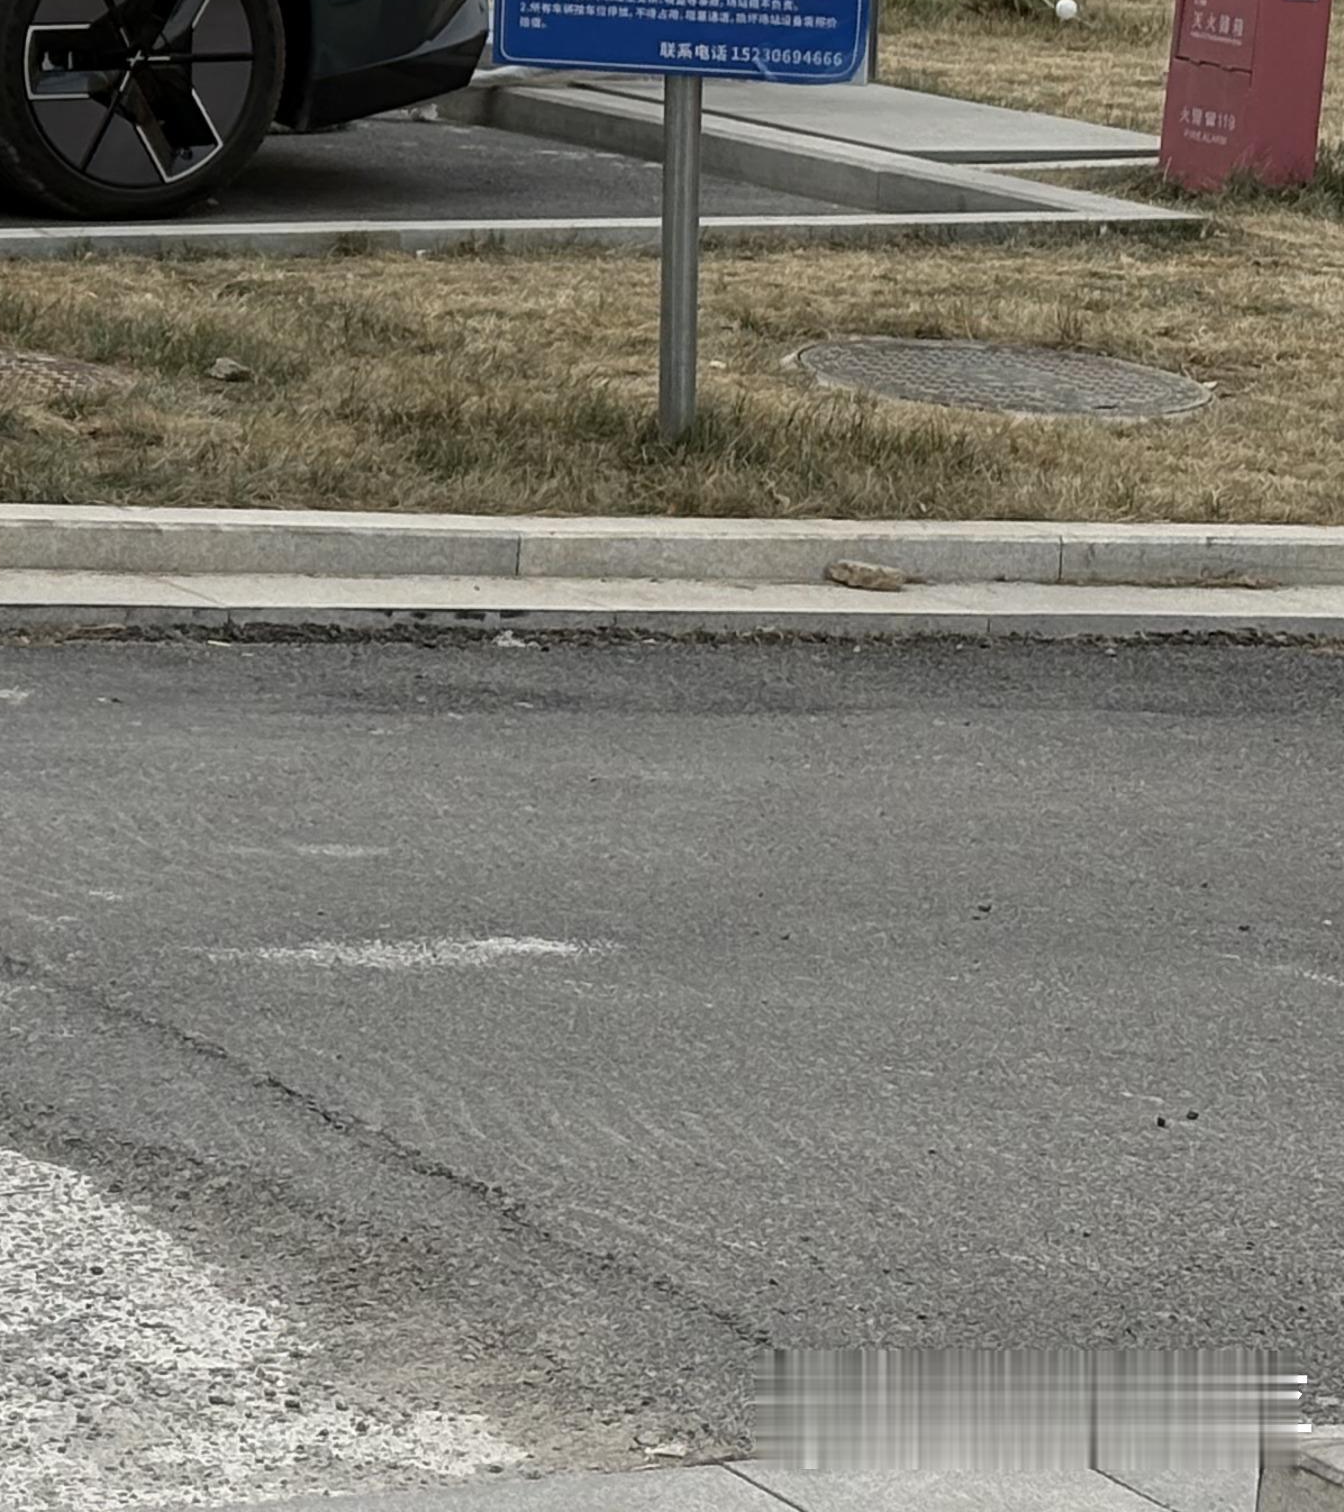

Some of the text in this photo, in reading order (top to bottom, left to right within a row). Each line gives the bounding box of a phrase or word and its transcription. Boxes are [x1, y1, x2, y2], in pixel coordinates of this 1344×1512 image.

[660, 42, 843, 66] 联系电话 15230694666
